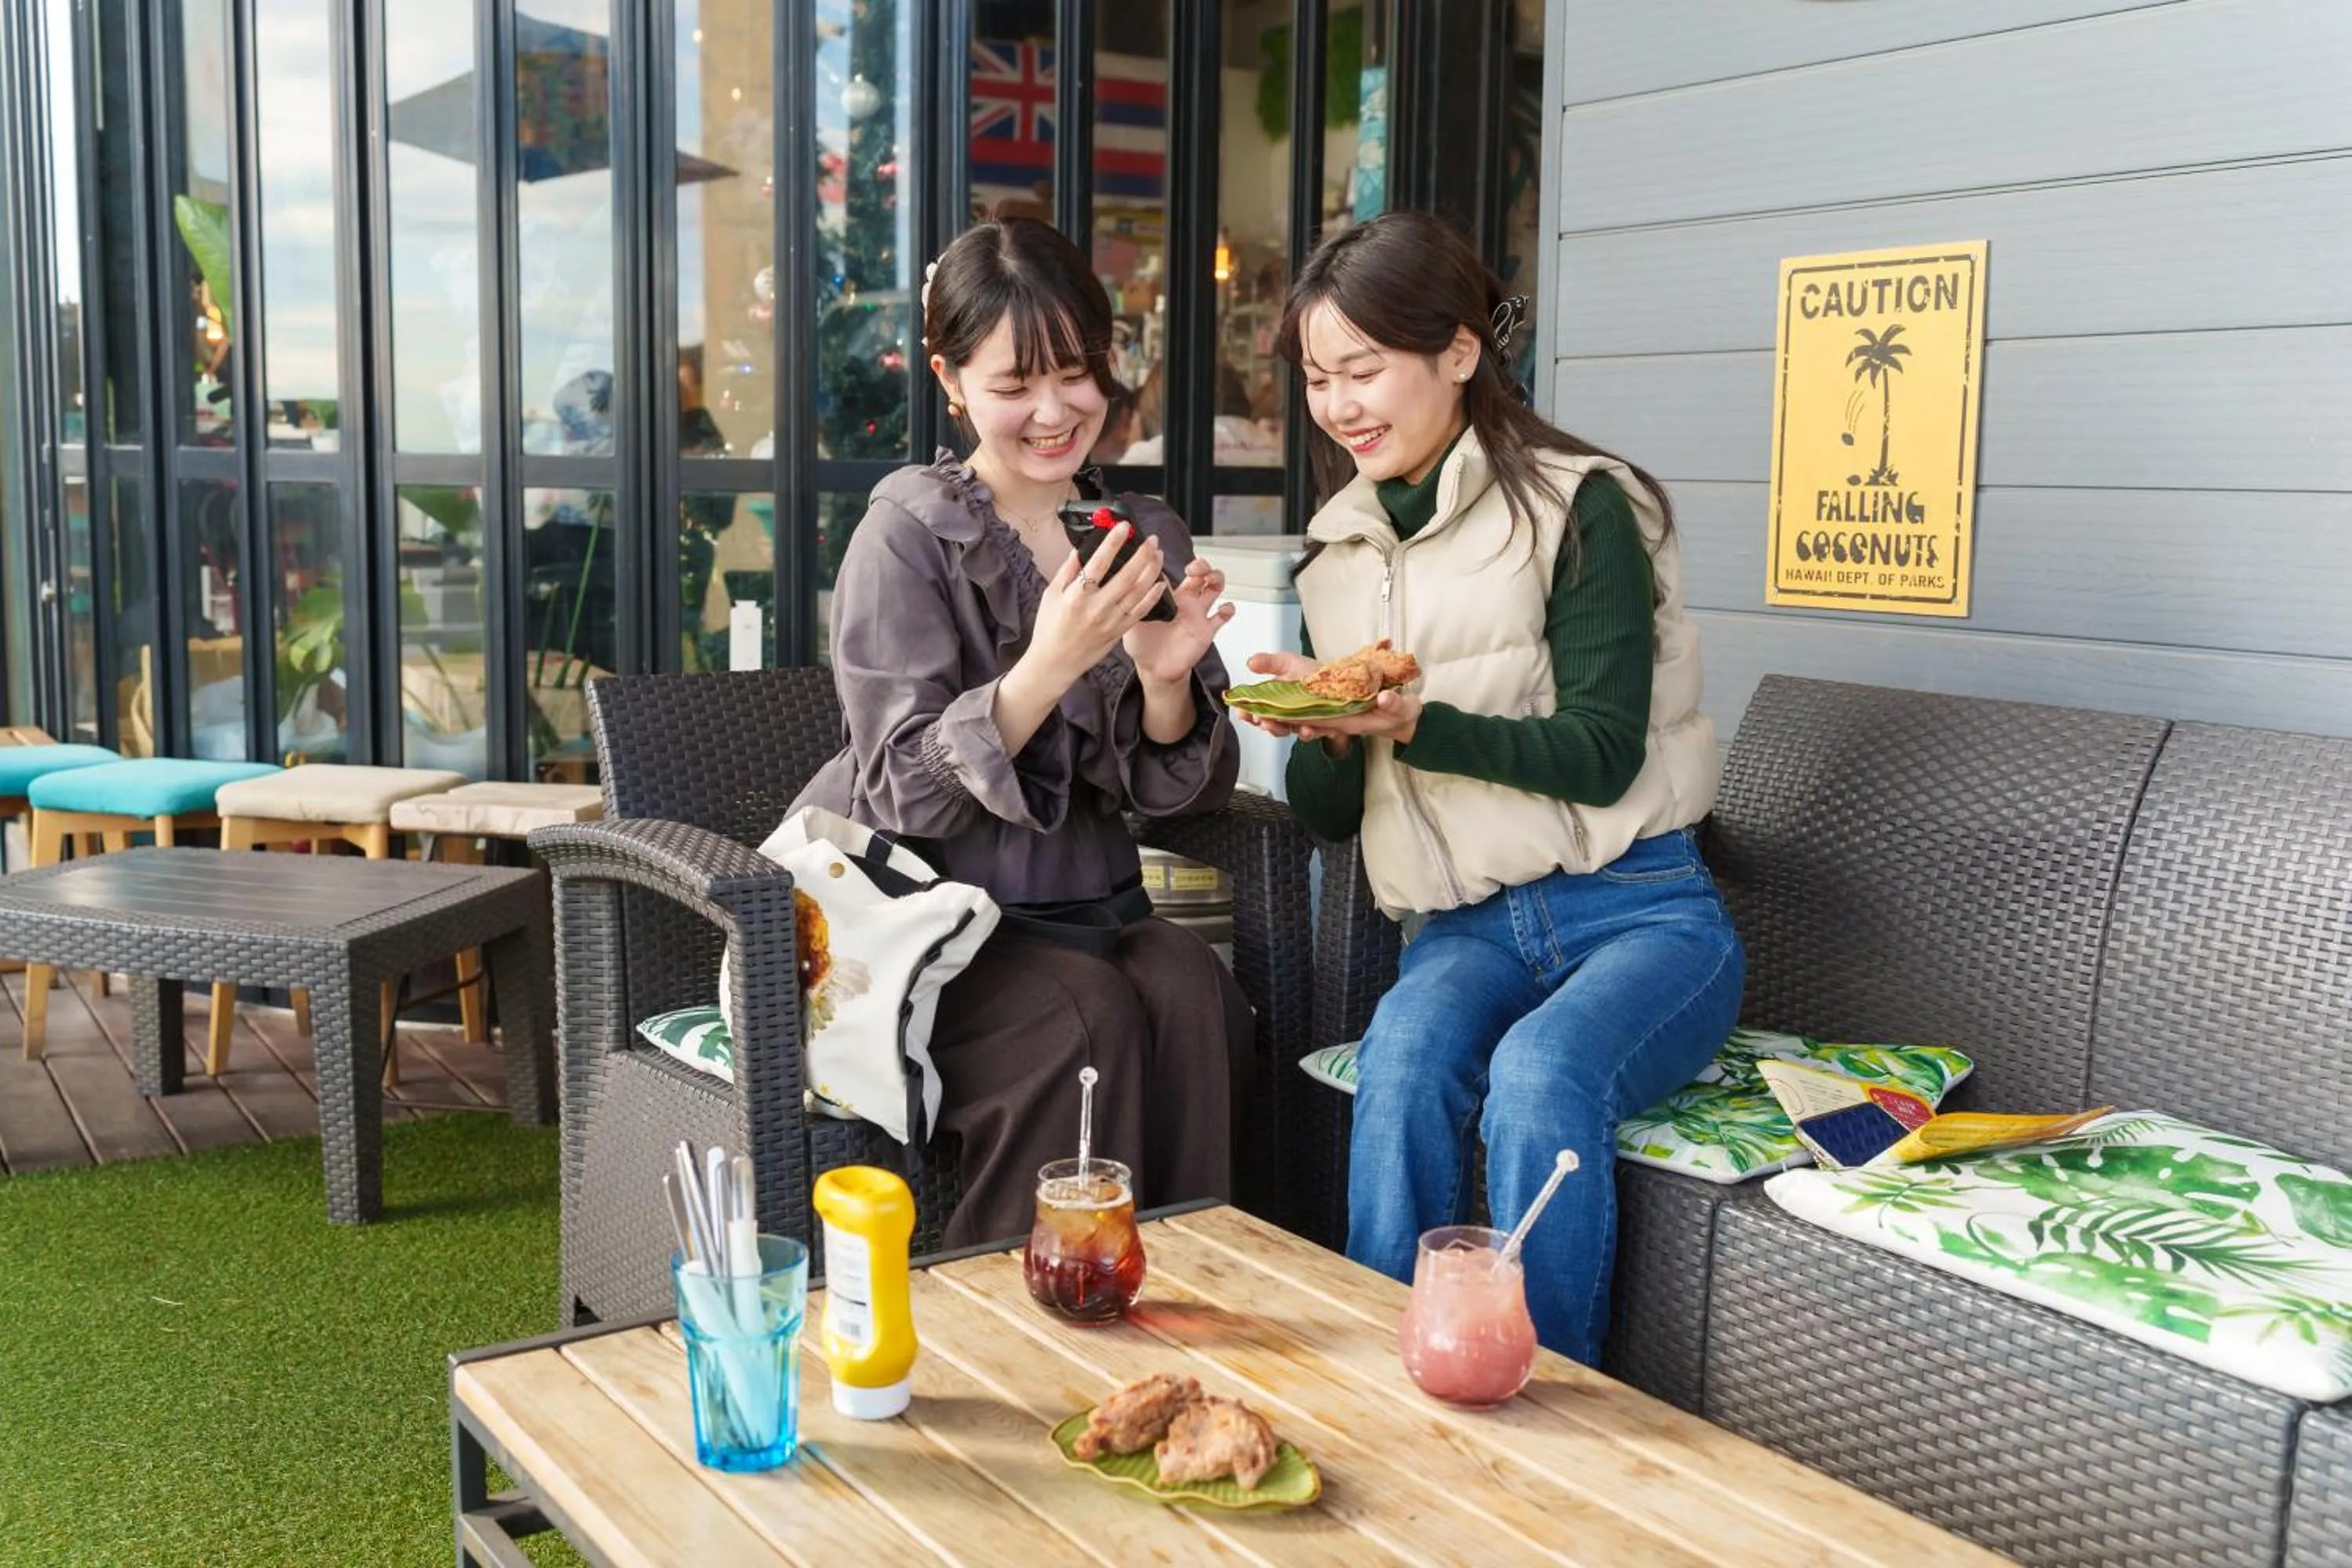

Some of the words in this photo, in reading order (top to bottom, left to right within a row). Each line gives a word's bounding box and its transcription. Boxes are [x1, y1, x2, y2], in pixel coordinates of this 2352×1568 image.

[1801, 272, 1959, 319] CAUTION
[1816, 490, 1926, 524] FALLING
[1796, 530, 1940, 568] COCONUTS
[1785, 568, 1833, 583] HAWAII
[1878, 573, 1896, 586] OF
[1900, 574, 1945, 589] PARKS
